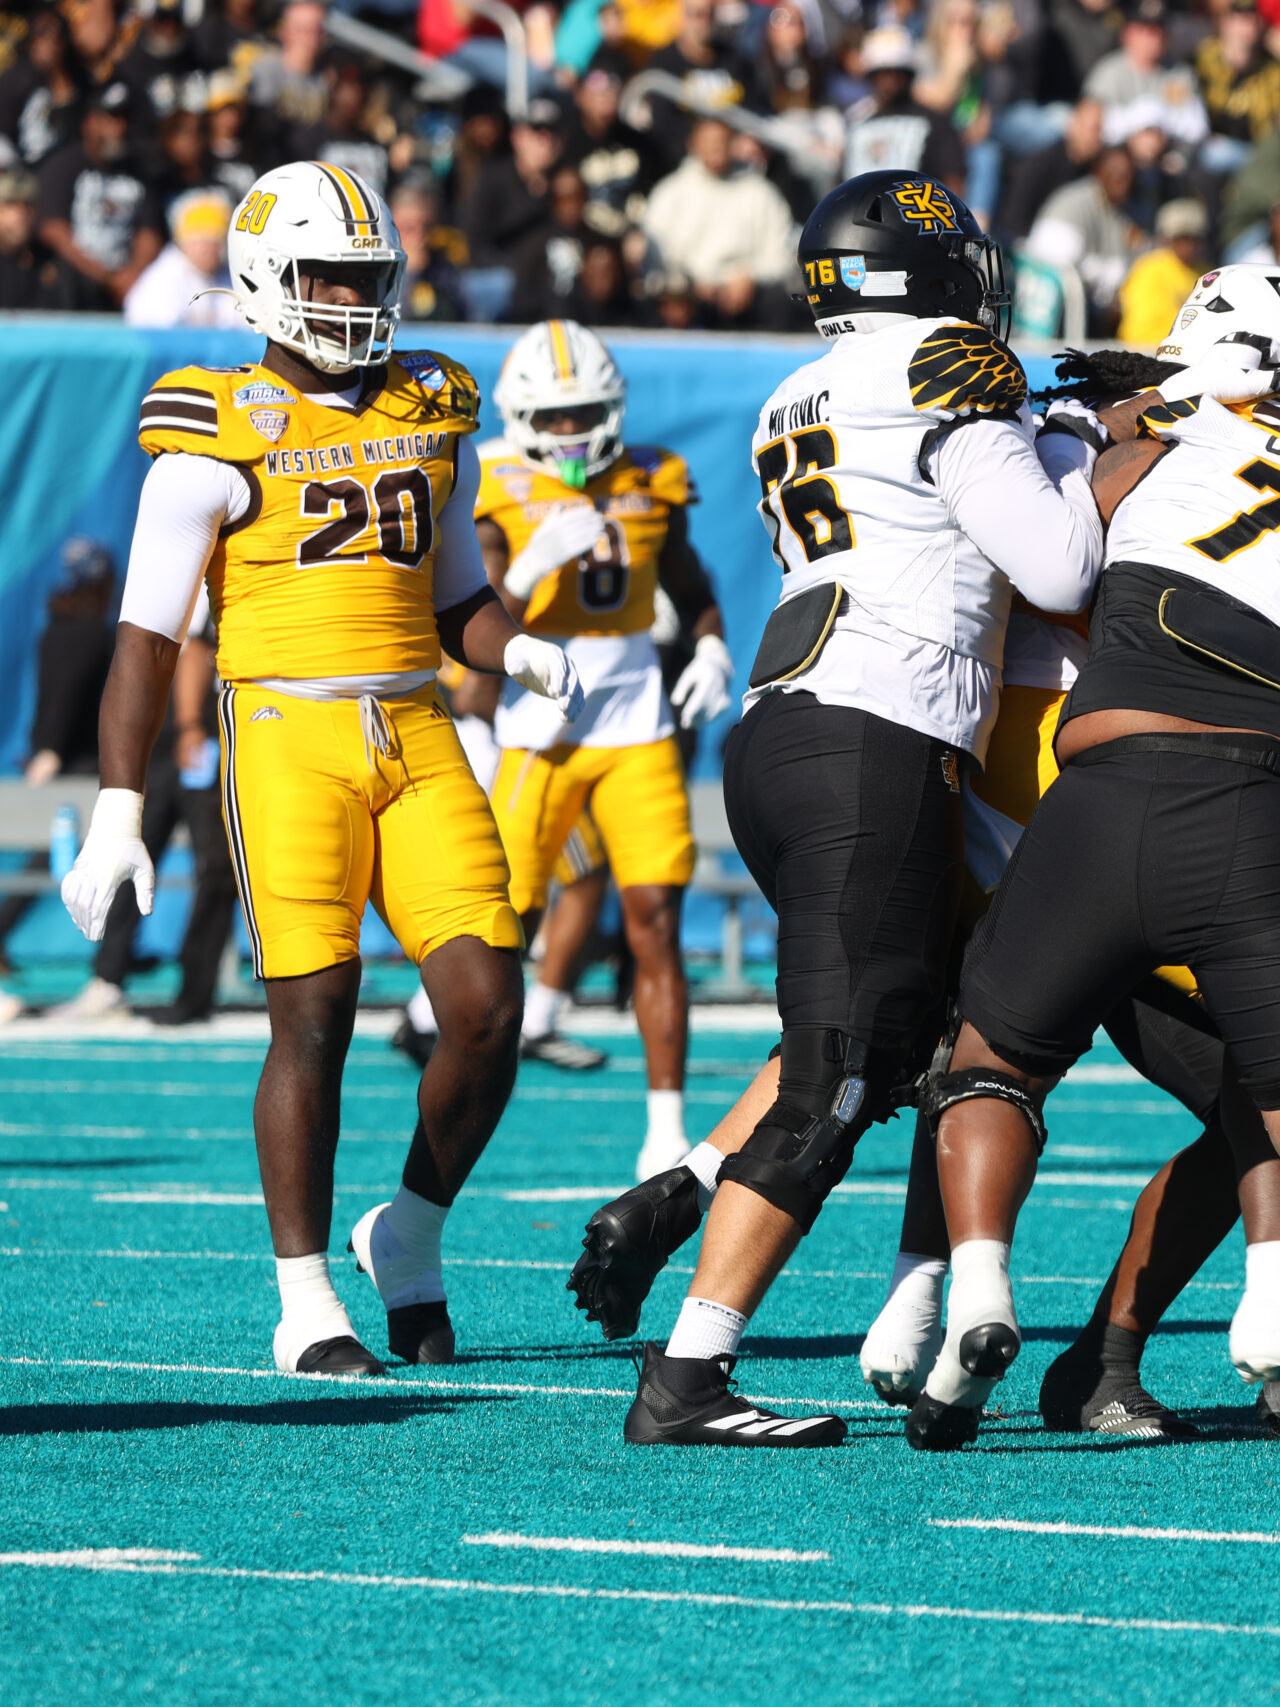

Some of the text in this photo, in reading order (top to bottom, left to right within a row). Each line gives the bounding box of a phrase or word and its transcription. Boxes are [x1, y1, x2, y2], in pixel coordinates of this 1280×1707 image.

[235, 190, 278, 235] 20
[351, 237, 383, 249] GRIT
[805, 258, 836, 288] 76
[821, 320, 856, 337] OWLS
[265, 431, 448, 477] WESTERN MICHIGAN
[296, 464, 434, 570] 20
[755, 424, 858, 575] 76
[975, 1081, 1031, 1102] DONJOY
